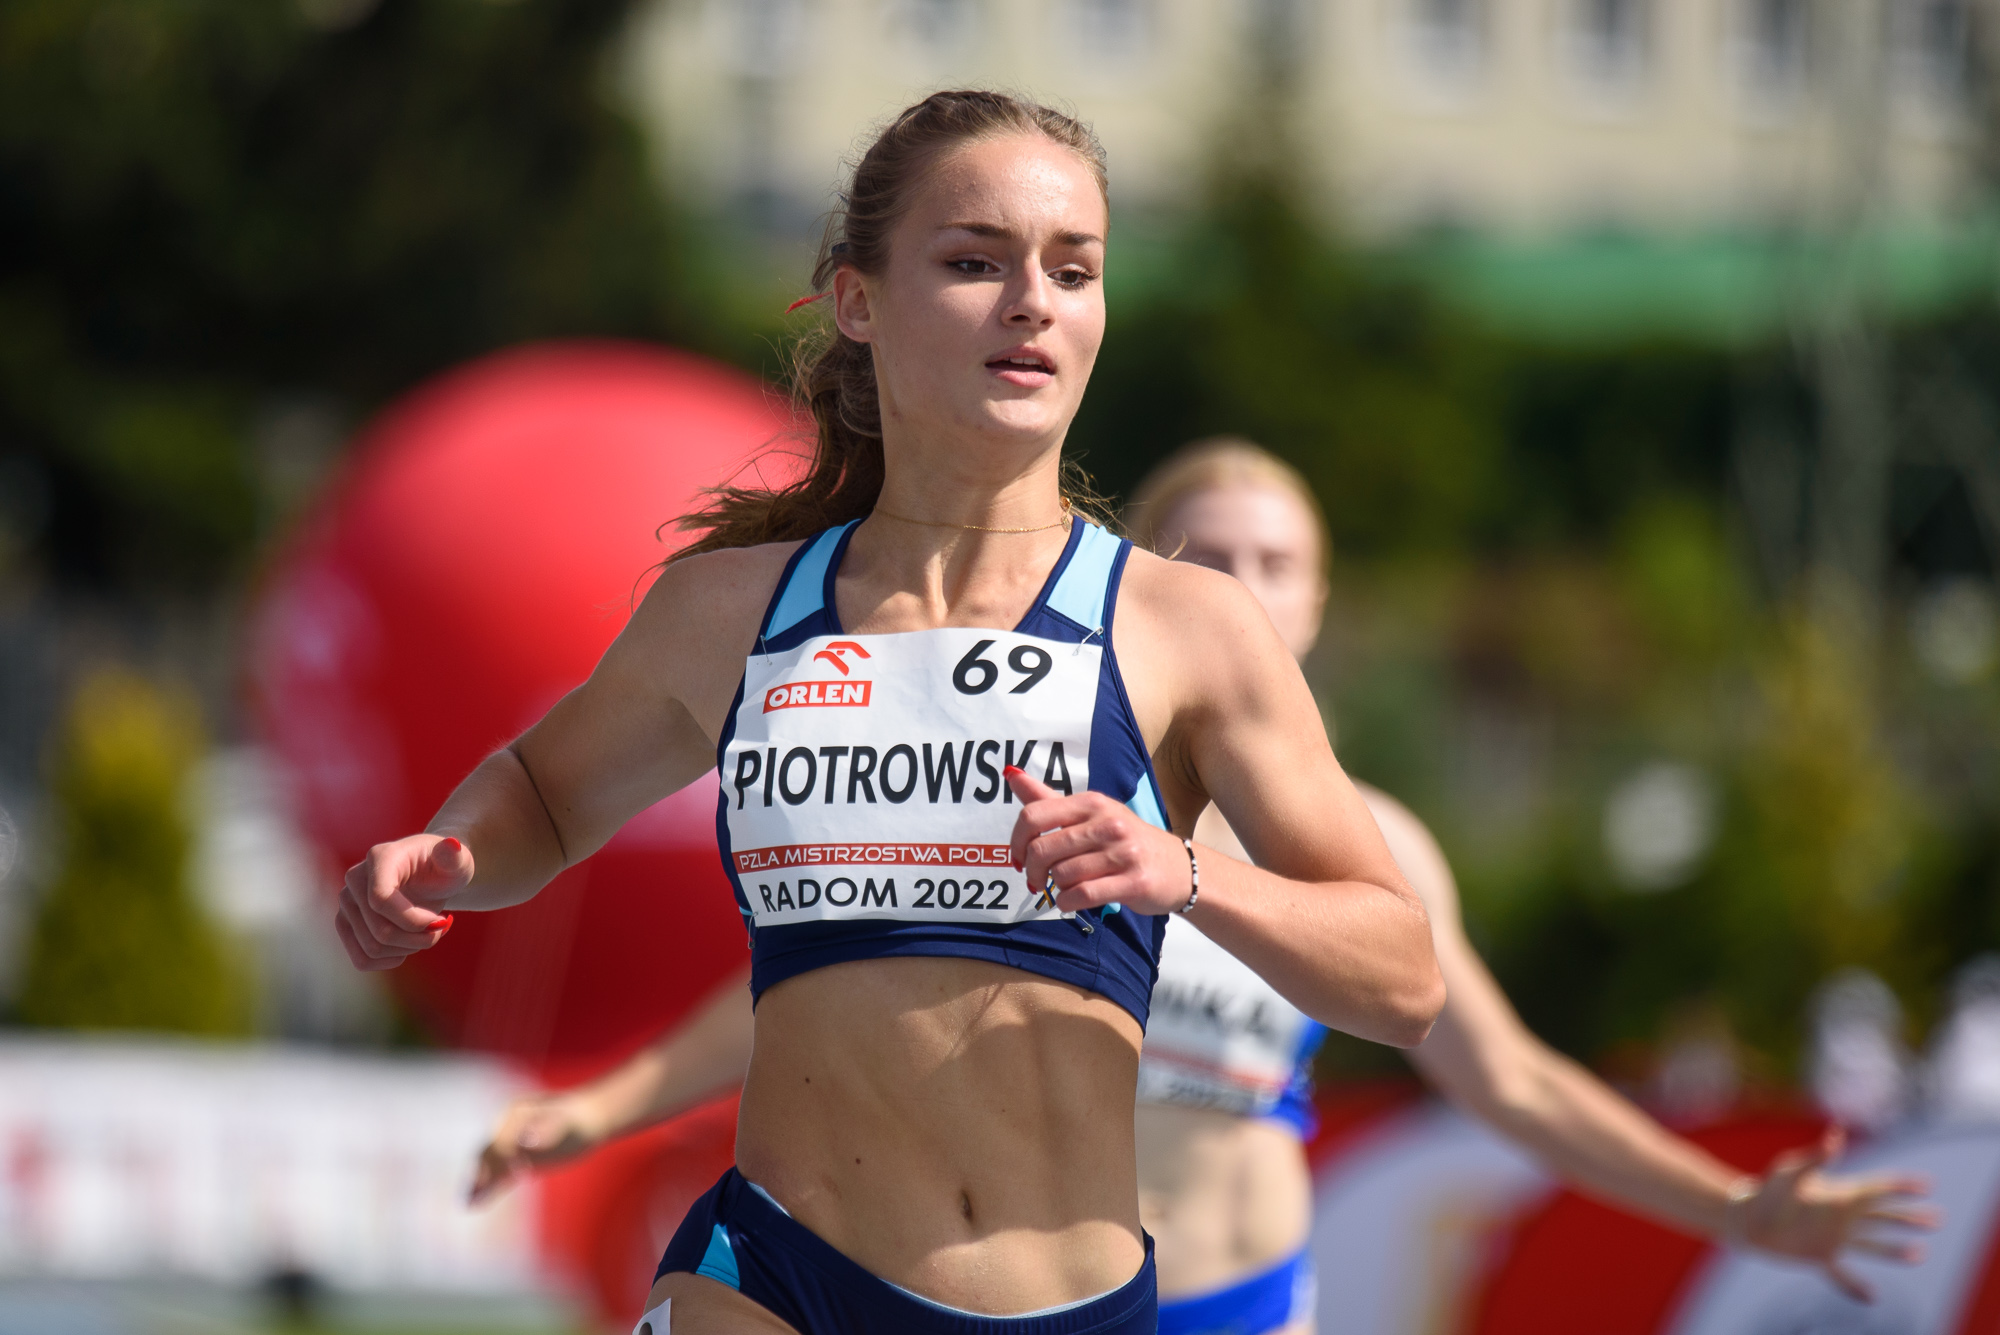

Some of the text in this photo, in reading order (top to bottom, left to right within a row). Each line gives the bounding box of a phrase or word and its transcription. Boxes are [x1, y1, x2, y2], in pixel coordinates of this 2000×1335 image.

[952, 639, 1053, 696] 69
[768, 684, 862, 708] ORLEN
[734, 739, 1073, 810] PIOTROWSKA
[739, 847, 1012, 870] PZLA MISTRZOSTWA POLS
[759, 877, 1010, 913] RADOM 2022
